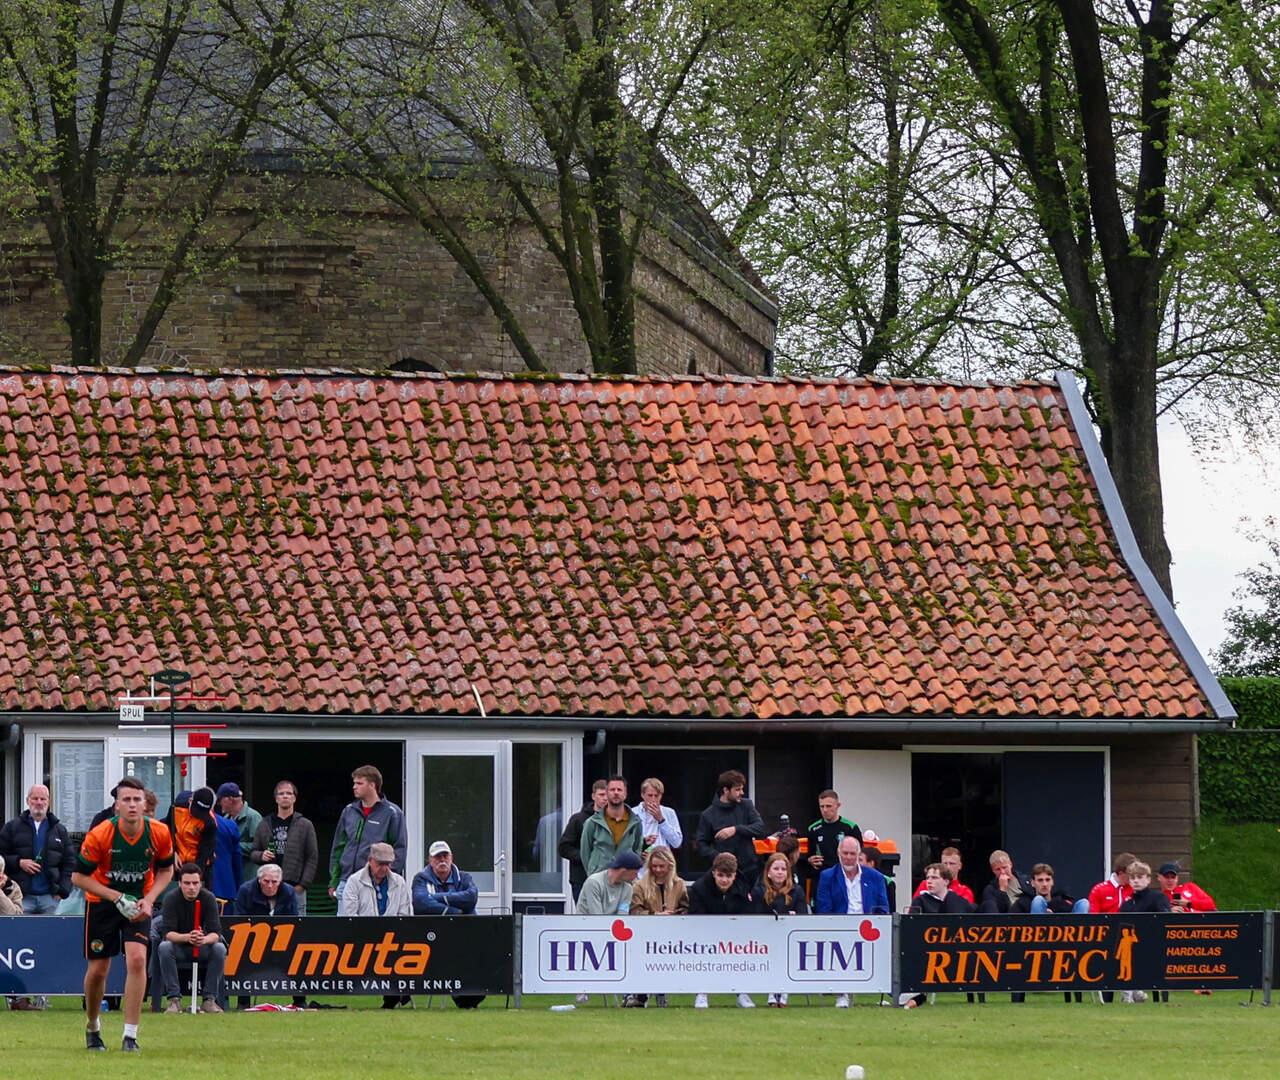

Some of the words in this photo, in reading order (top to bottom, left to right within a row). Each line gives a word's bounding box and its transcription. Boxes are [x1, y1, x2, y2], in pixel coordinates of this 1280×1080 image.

[122, 707, 141, 718] SPUL
[924, 925, 1110, 943] GLASZETBEDRIJF
[1165, 929, 1238, 940] ISOLATIEGLAS
[287, 931, 431, 976] muta
[645, 940, 769, 955] HeidstraMedia
[1165, 947, 1222, 957] HARDGLAS
[547, 940, 618, 971] HM
[796, 940, 865, 971] HM
[645, 961, 769, 972] www.heidstramedia.nl
[921, 949, 1109, 984] RIN-TEC
[1165, 964, 1226, 974] ENKELGLAS
[361, 980, 391, 990] VAN
[399, 980, 416, 990] DE
[423, 980, 462, 990] KNKB
